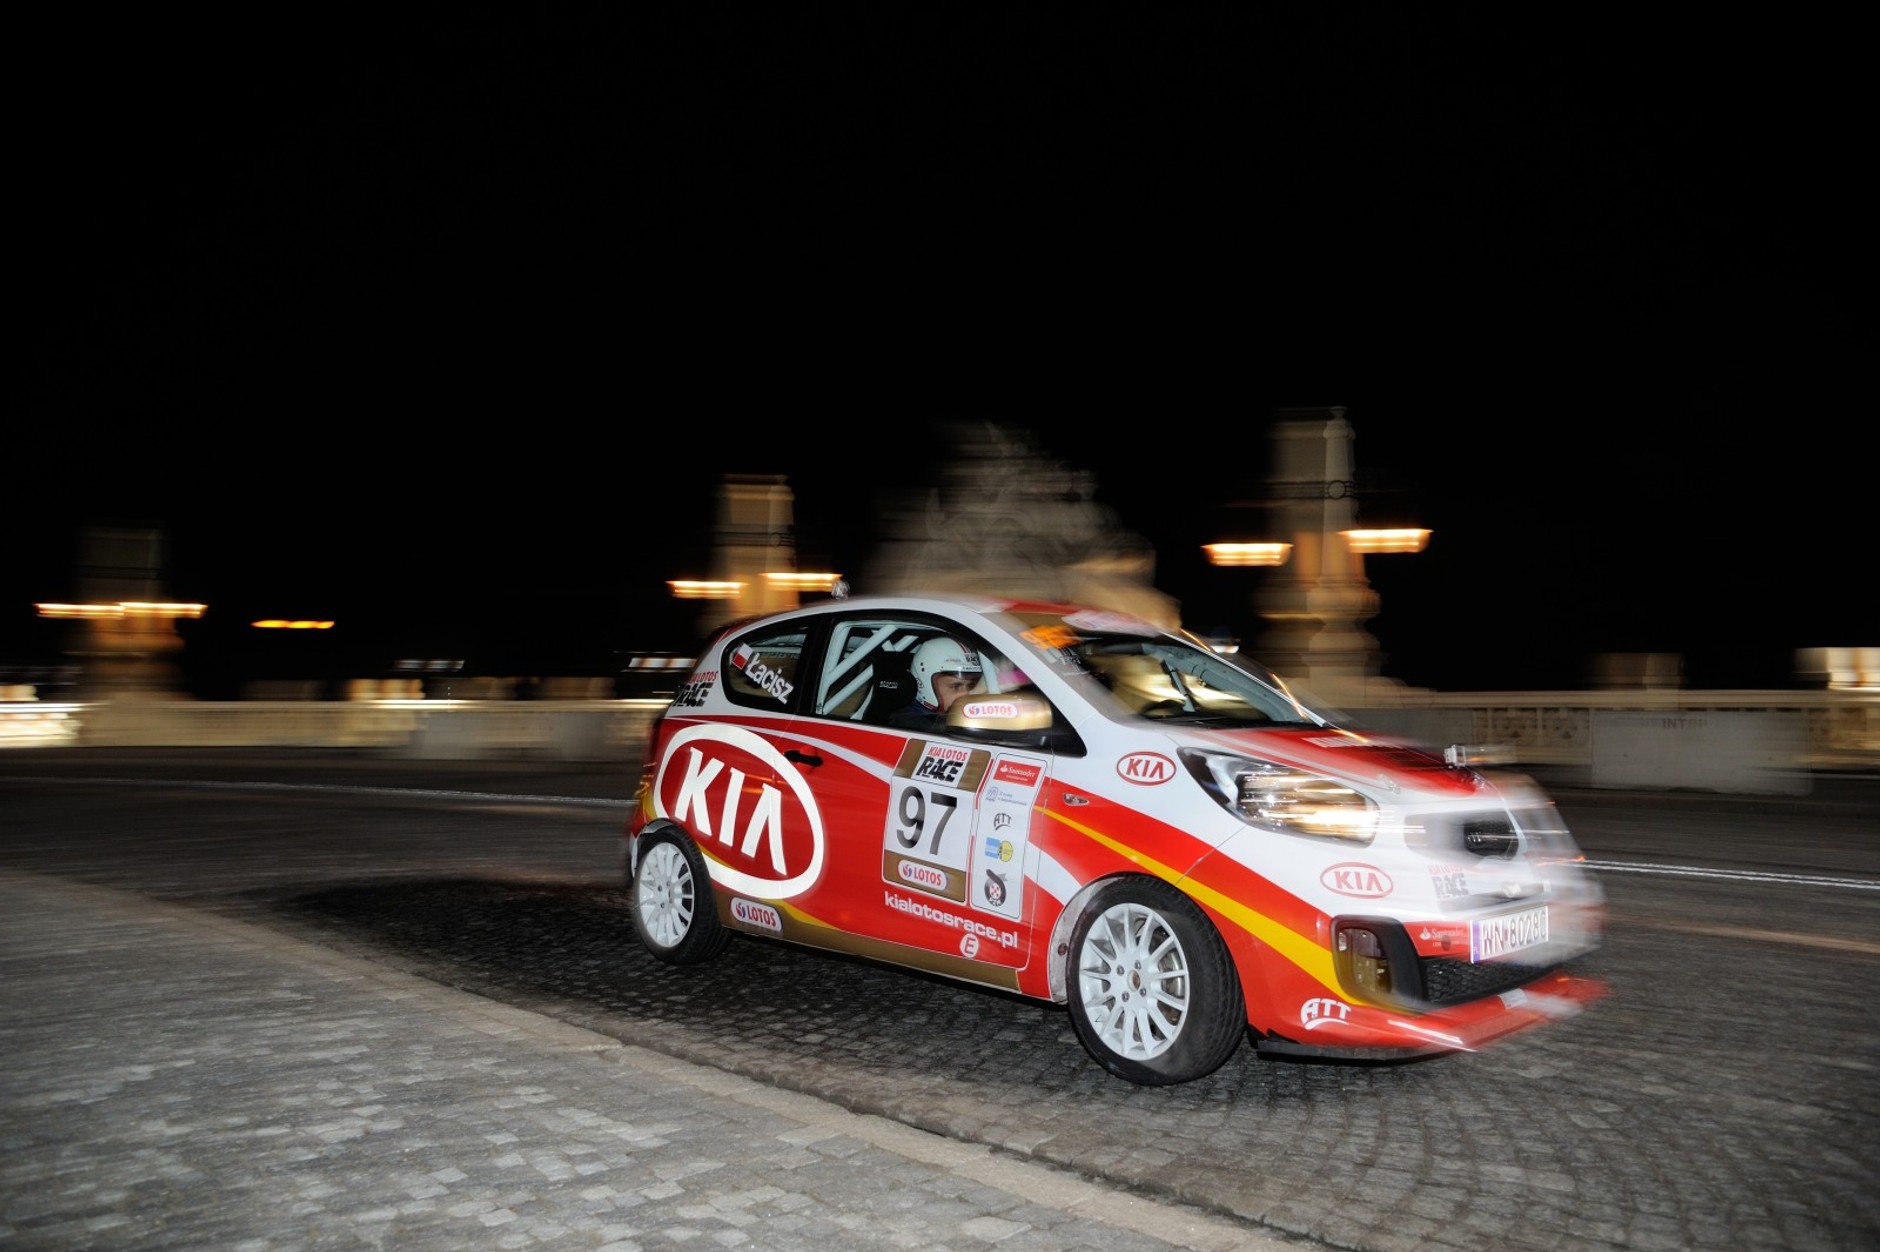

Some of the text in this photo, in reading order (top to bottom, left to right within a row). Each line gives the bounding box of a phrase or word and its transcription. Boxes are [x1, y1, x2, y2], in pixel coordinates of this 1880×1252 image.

[981, 705, 1012, 716] LOTOS
[916, 756, 964, 783] RACE
[1126, 758, 1164, 779] KIA
[674, 746, 788, 876] KIA
[896, 786, 958, 856] 97
[993, 812, 1012, 828] ATT
[913, 867, 942, 886] LOTOS
[1334, 871, 1384, 892] KIA
[746, 905, 777, 928] LOTOS
[884, 891, 1018, 948] kialotosrace.pl
[964, 937, 976, 955] E
[1482, 922, 1504, 957] WN
[1300, 998, 1351, 1024] ATT
